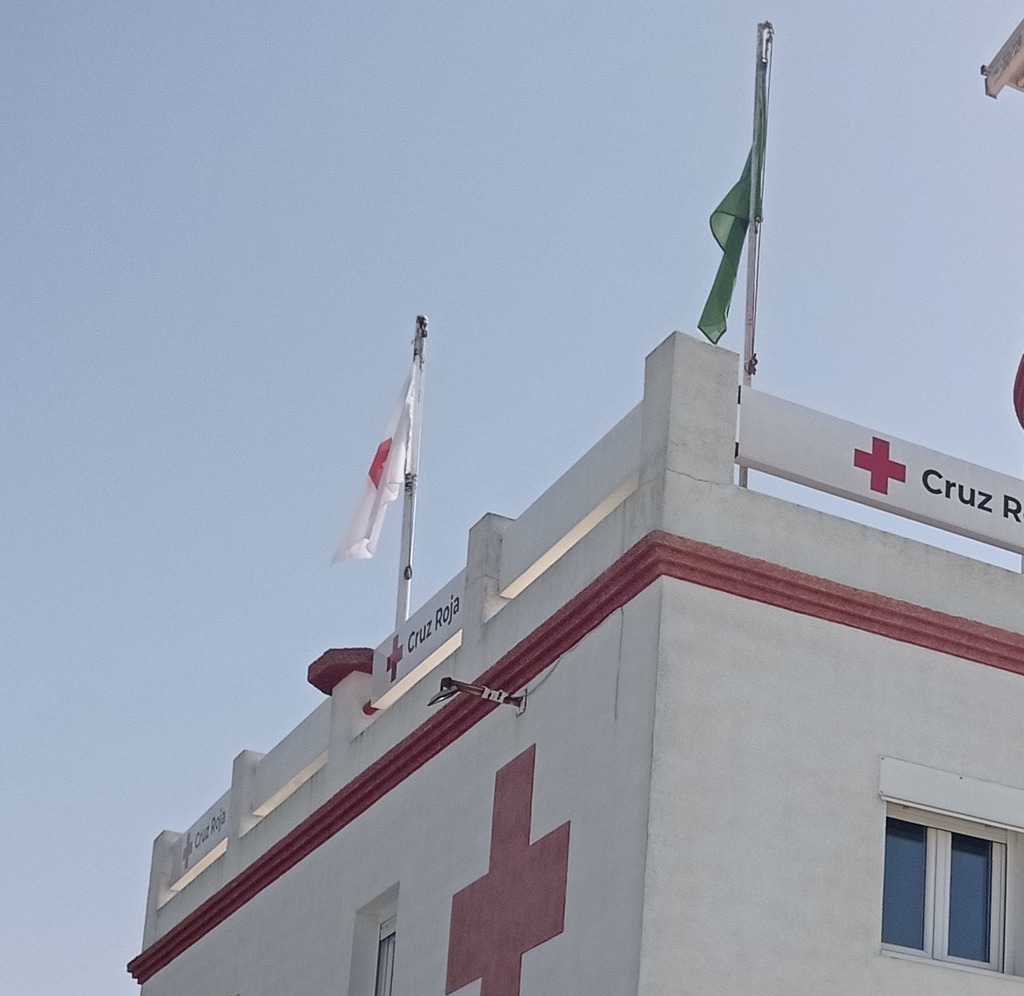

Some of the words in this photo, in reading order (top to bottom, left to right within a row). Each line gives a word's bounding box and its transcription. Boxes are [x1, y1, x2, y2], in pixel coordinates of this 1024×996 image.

[922, 469, 993, 513] Cruz
[407, 620, 433, 653] Cruz
[435, 594, 460, 631] Roja
[194, 825, 210, 848] Cruz
[210, 809, 226, 835] Roja
